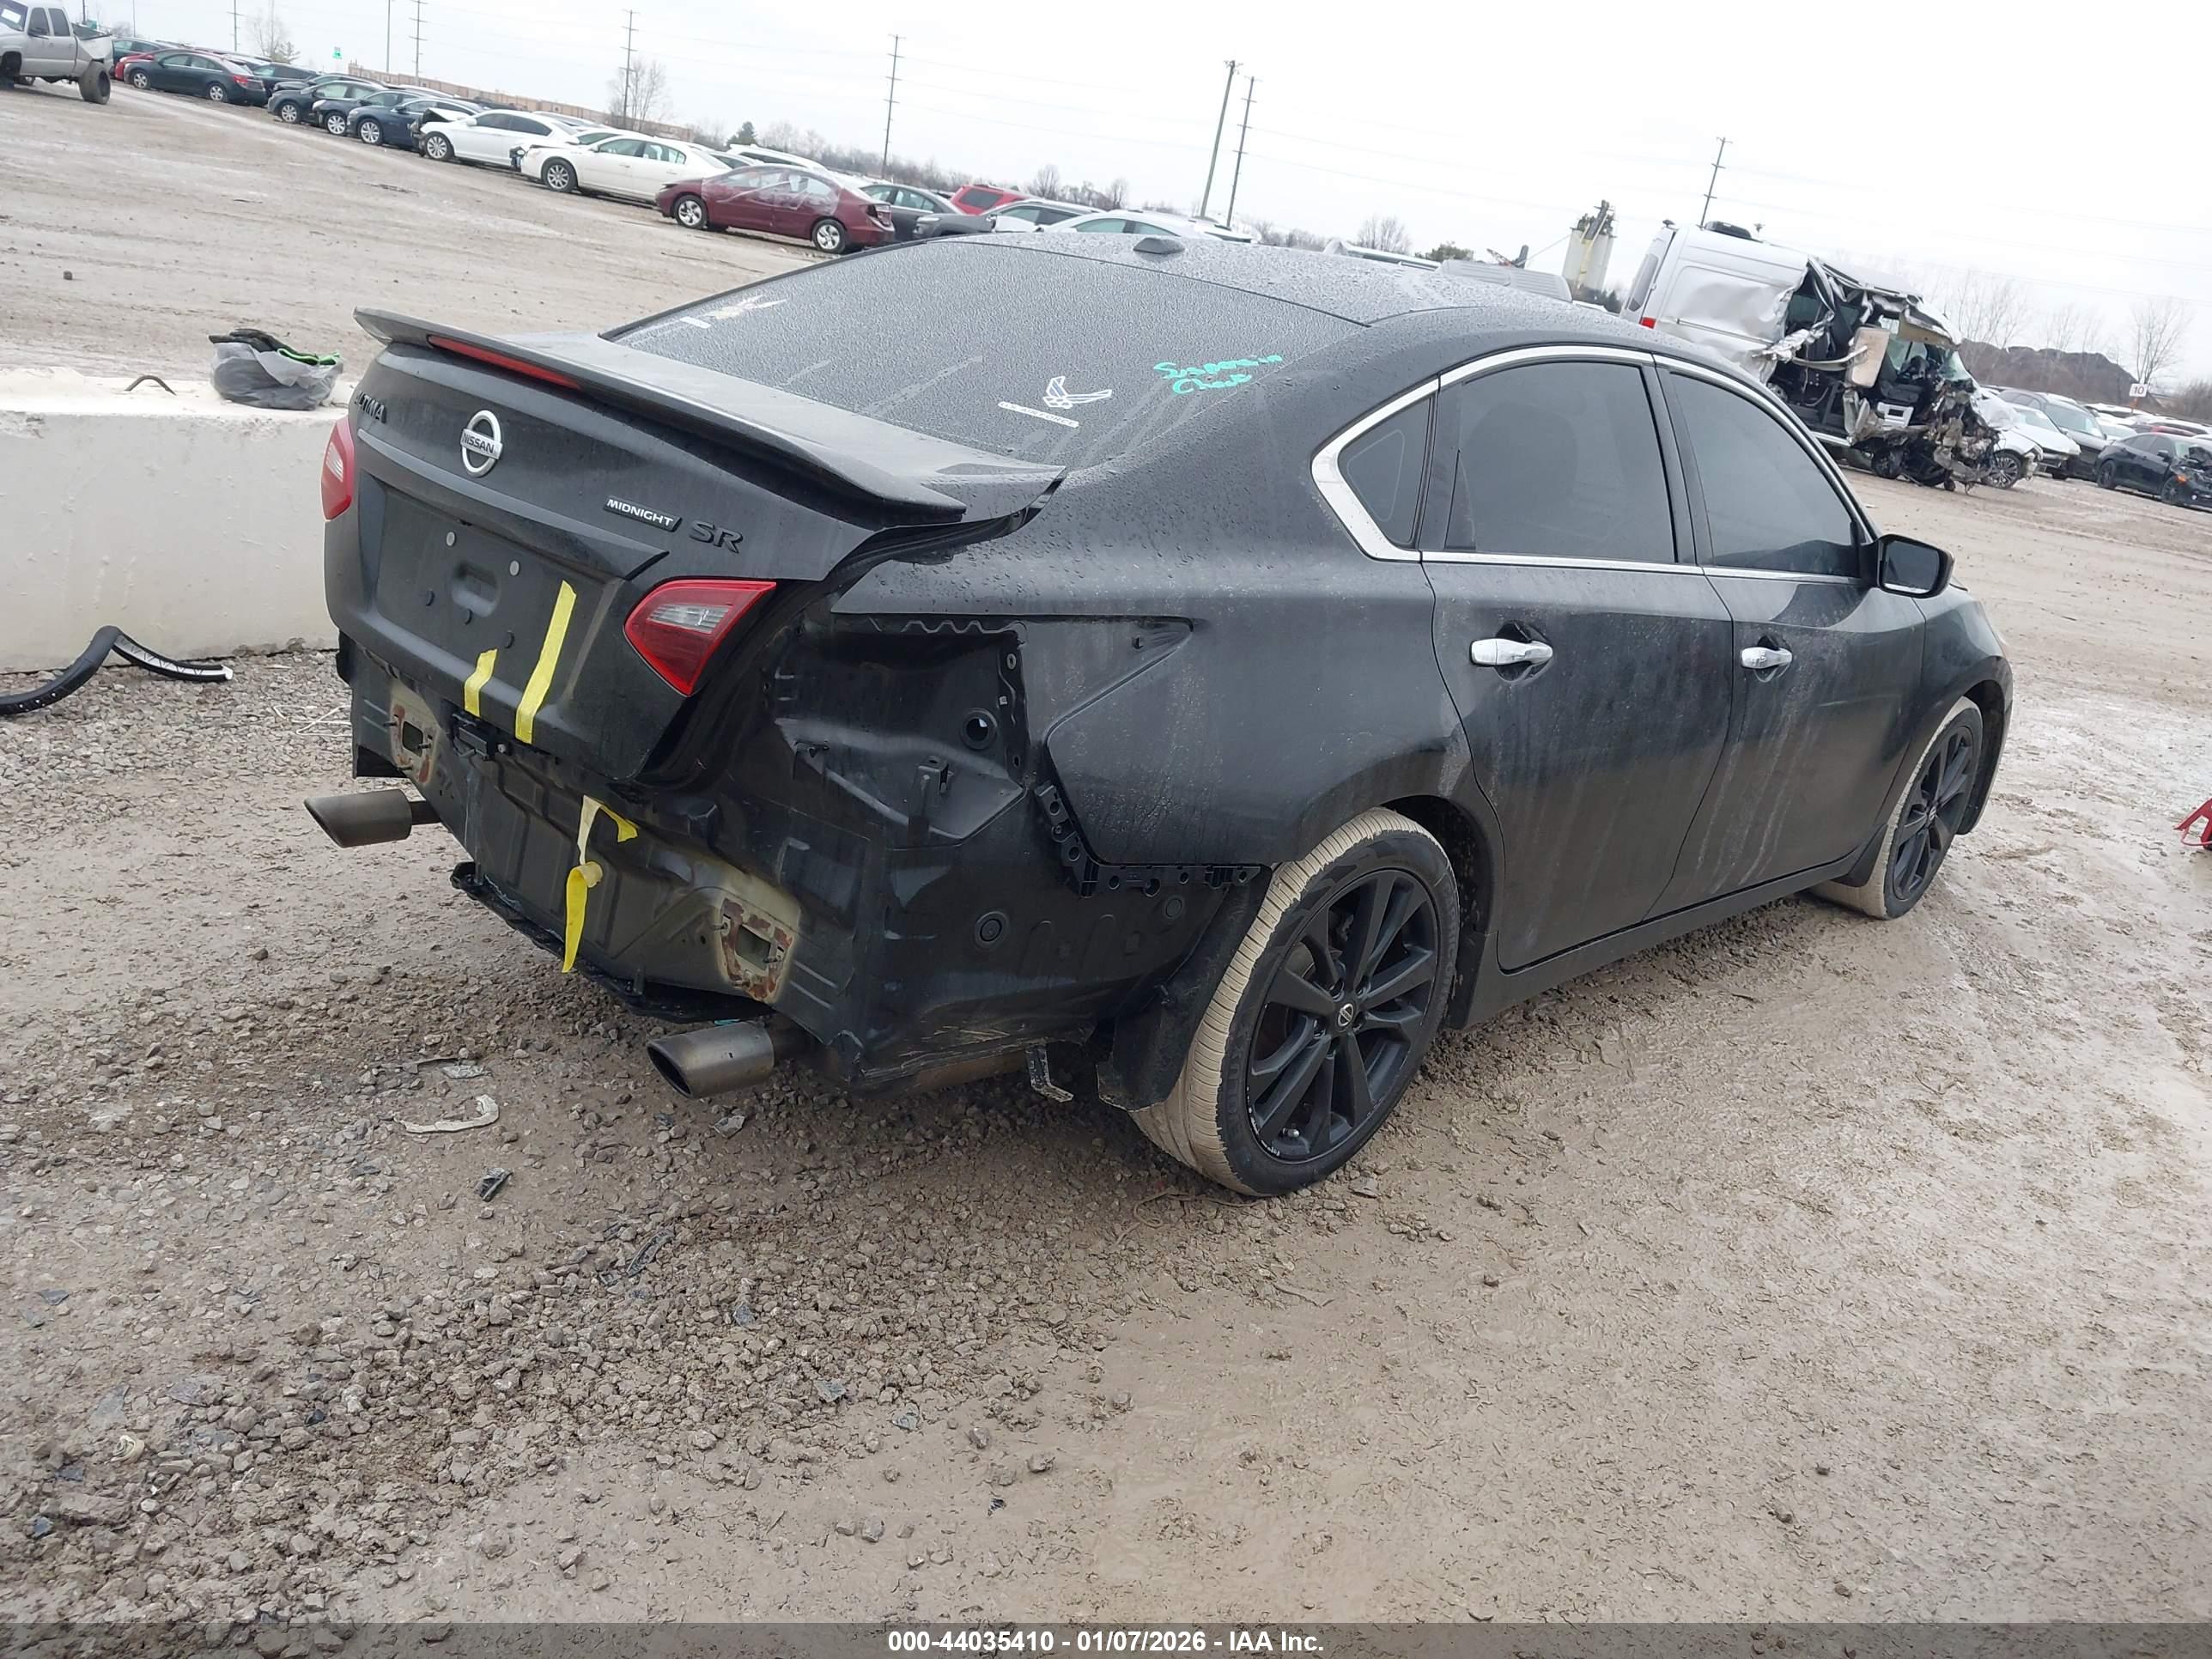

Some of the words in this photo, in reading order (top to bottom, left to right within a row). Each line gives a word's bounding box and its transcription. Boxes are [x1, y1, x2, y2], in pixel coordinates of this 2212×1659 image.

[2134, 386, 2145, 395] 10
[462, 431, 495, 454] NISSAN
[605, 498, 675, 526] MIDNIGHT
[690, 520, 744, 554] SR
